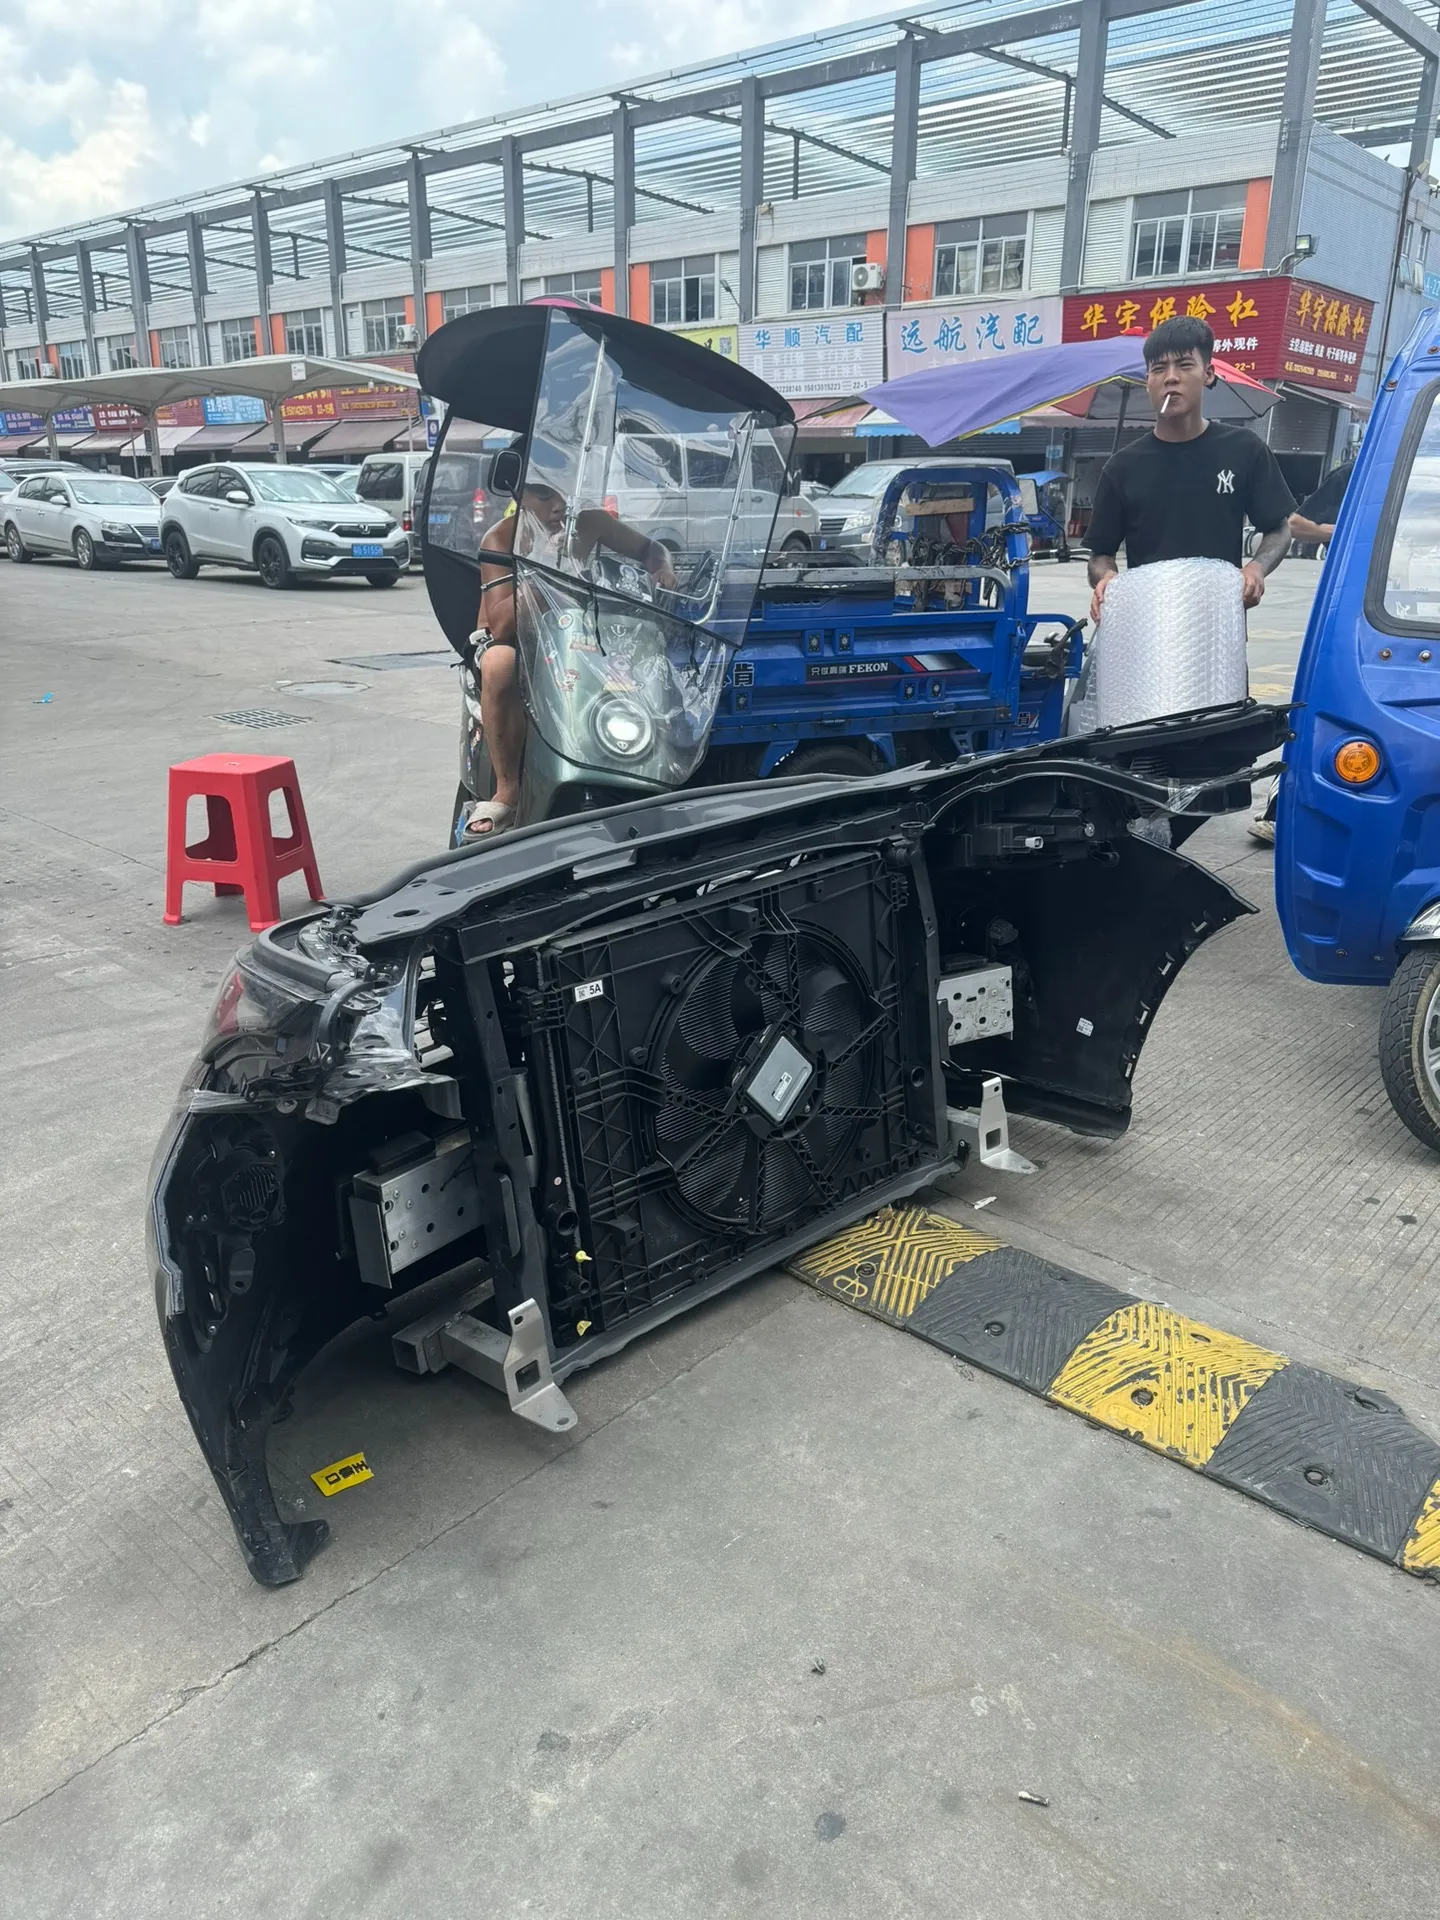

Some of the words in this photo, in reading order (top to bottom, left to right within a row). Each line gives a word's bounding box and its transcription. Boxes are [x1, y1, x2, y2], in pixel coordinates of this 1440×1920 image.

[1080, 290, 1259, 338] 华宇保险杠
[1296, 289, 1365, 340] 华宇保险杠
[755, 322, 863, 350] 华顺汽配
[901, 312, 1044, 354] 远航汽配
[1235, 361, 1255, 371] 22-1
[853, 380, 869, 389] 22-5
[1216, 469, 1235, 494] NY
[848, 662, 889, 674] FEKON
[589, 983, 602, 994] 5A
